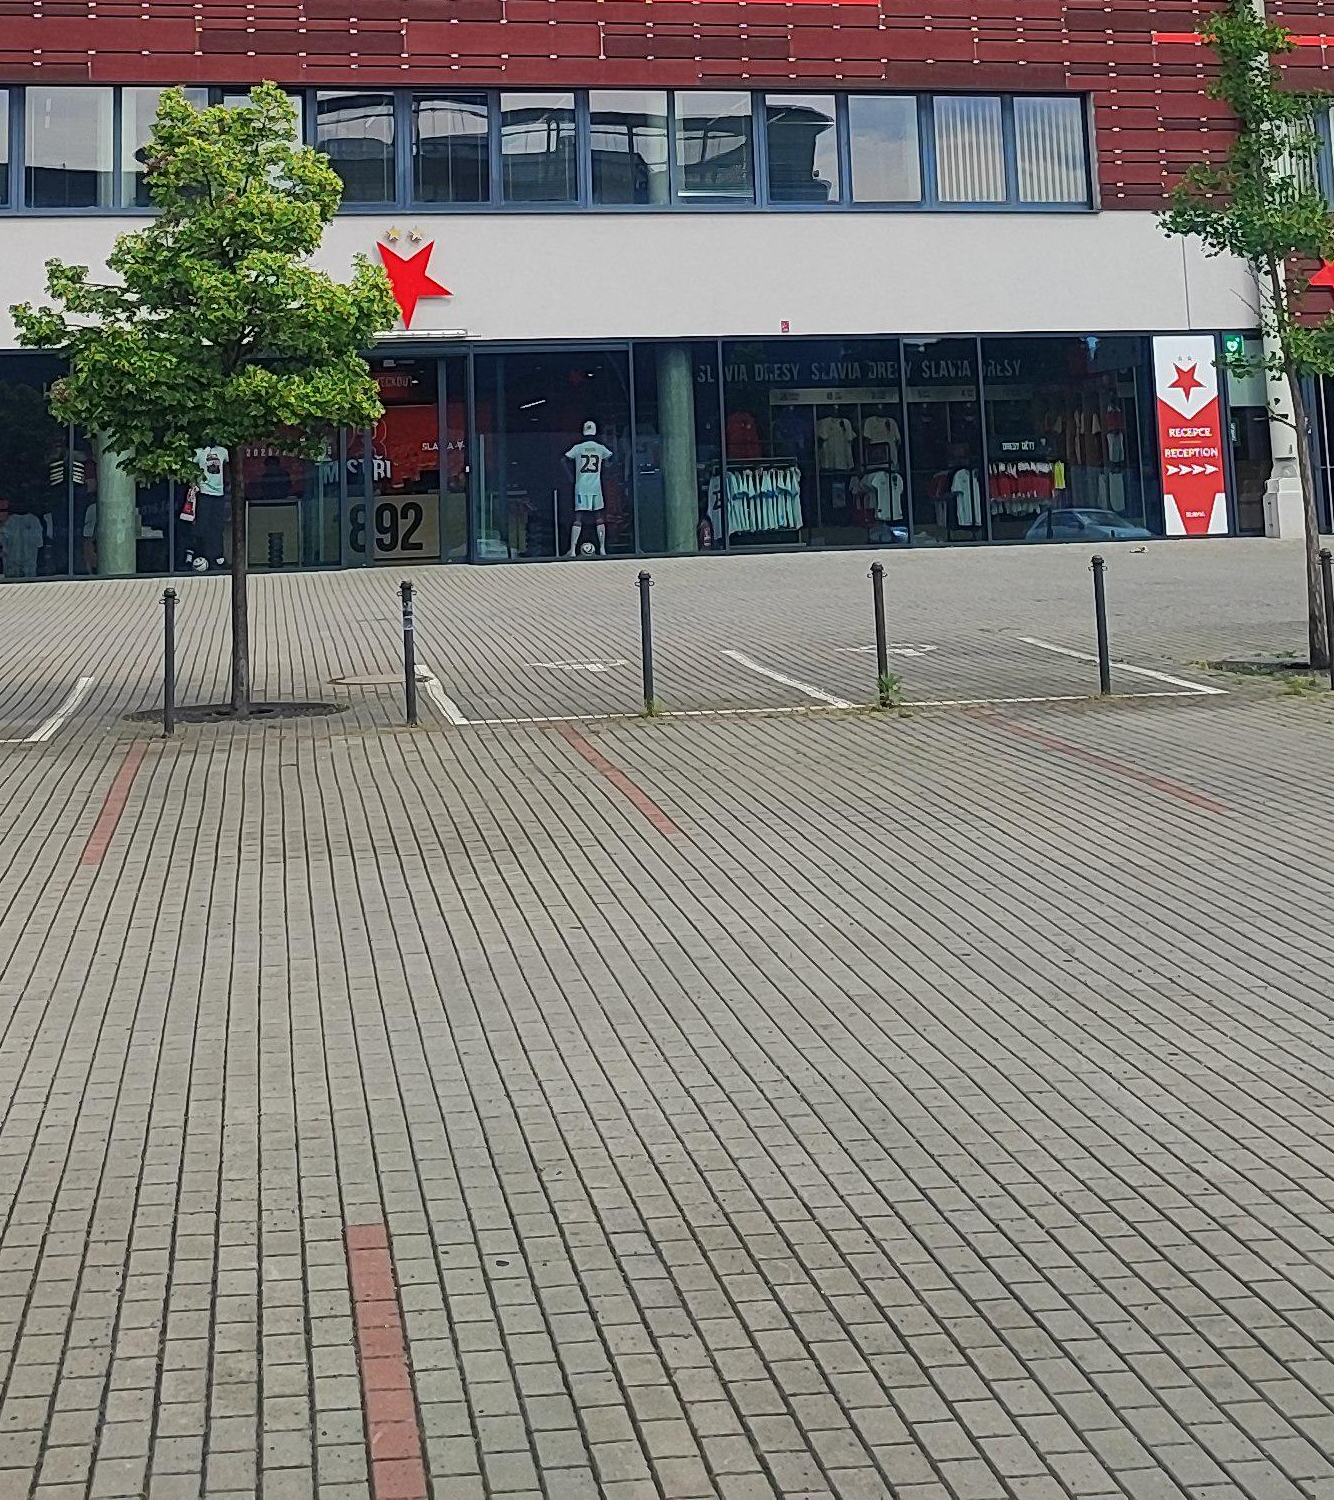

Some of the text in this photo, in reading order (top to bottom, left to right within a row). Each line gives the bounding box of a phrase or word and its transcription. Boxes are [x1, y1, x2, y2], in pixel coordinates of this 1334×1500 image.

[697, 364, 748, 383] SLVIA
[754, 363, 800, 382] DRESY
[811, 362, 863, 381] SLAVIA
[920, 359, 972, 379] SLAVIA
[1169, 427, 1213, 438] RECEPCE
[421, 441, 455, 451] SLAA
[1164, 447, 1219, 459] RECEPTION
[323, 454, 392, 484] MSTŘI
[580, 454, 599, 473] 23
